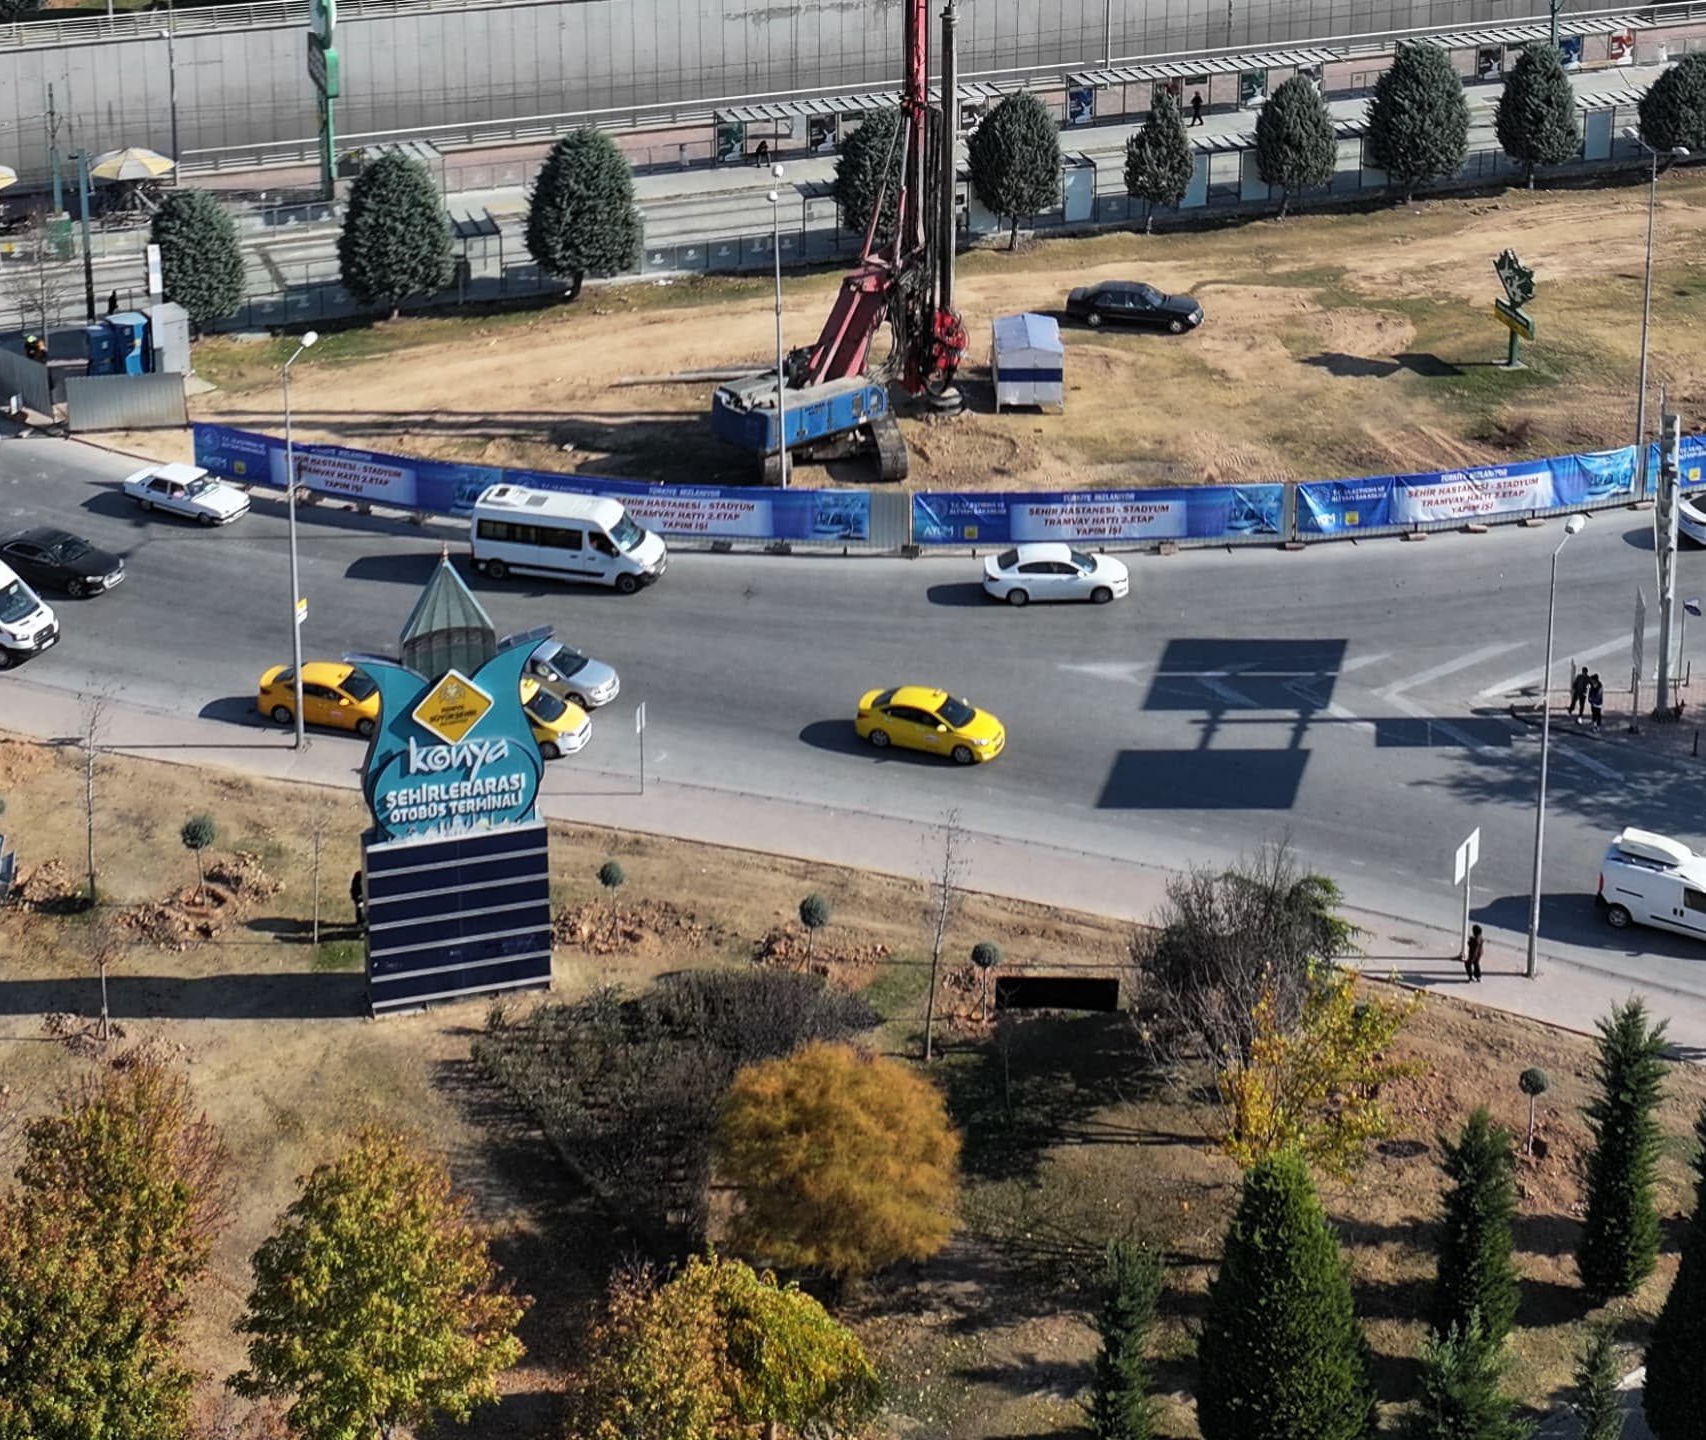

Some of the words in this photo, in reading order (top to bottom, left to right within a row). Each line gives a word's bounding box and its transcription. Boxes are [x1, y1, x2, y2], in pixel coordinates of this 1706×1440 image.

[1438, 482, 1490, 496] HASTANESİ
[1495, 477, 1539, 490] STADYUM
[646, 499, 701, 510] HASTANESİ
[708, 502, 755, 512] STADYUM
[1421, 496, 1466, 507] TRAMVAY
[630, 509, 675, 518] TRAMVAY
[678, 511, 705, 520] HATTI
[708, 513, 740, 521] 2.ETAP
[1029, 505, 1060, 516] ŞEHİR
[1062, 505, 1115, 515] HASTANESİ
[1123, 504, 1170, 513] STADYUM
[662, 521, 693, 529] YAPIM
[1043, 517, 1089, 527] TRAMVAY
[1092, 516, 1119, 525] HATTI
[1120, 515, 1154, 524] 2.ETAP
[1075, 527, 1106, 536] YAPIM
[409, 736, 509, 782] konya
[386, 773, 525, 809] ŞEHİRLERARASI
[390, 802, 447, 823] OTOBÜS
[449, 791, 523, 815] TERMİNALİ
